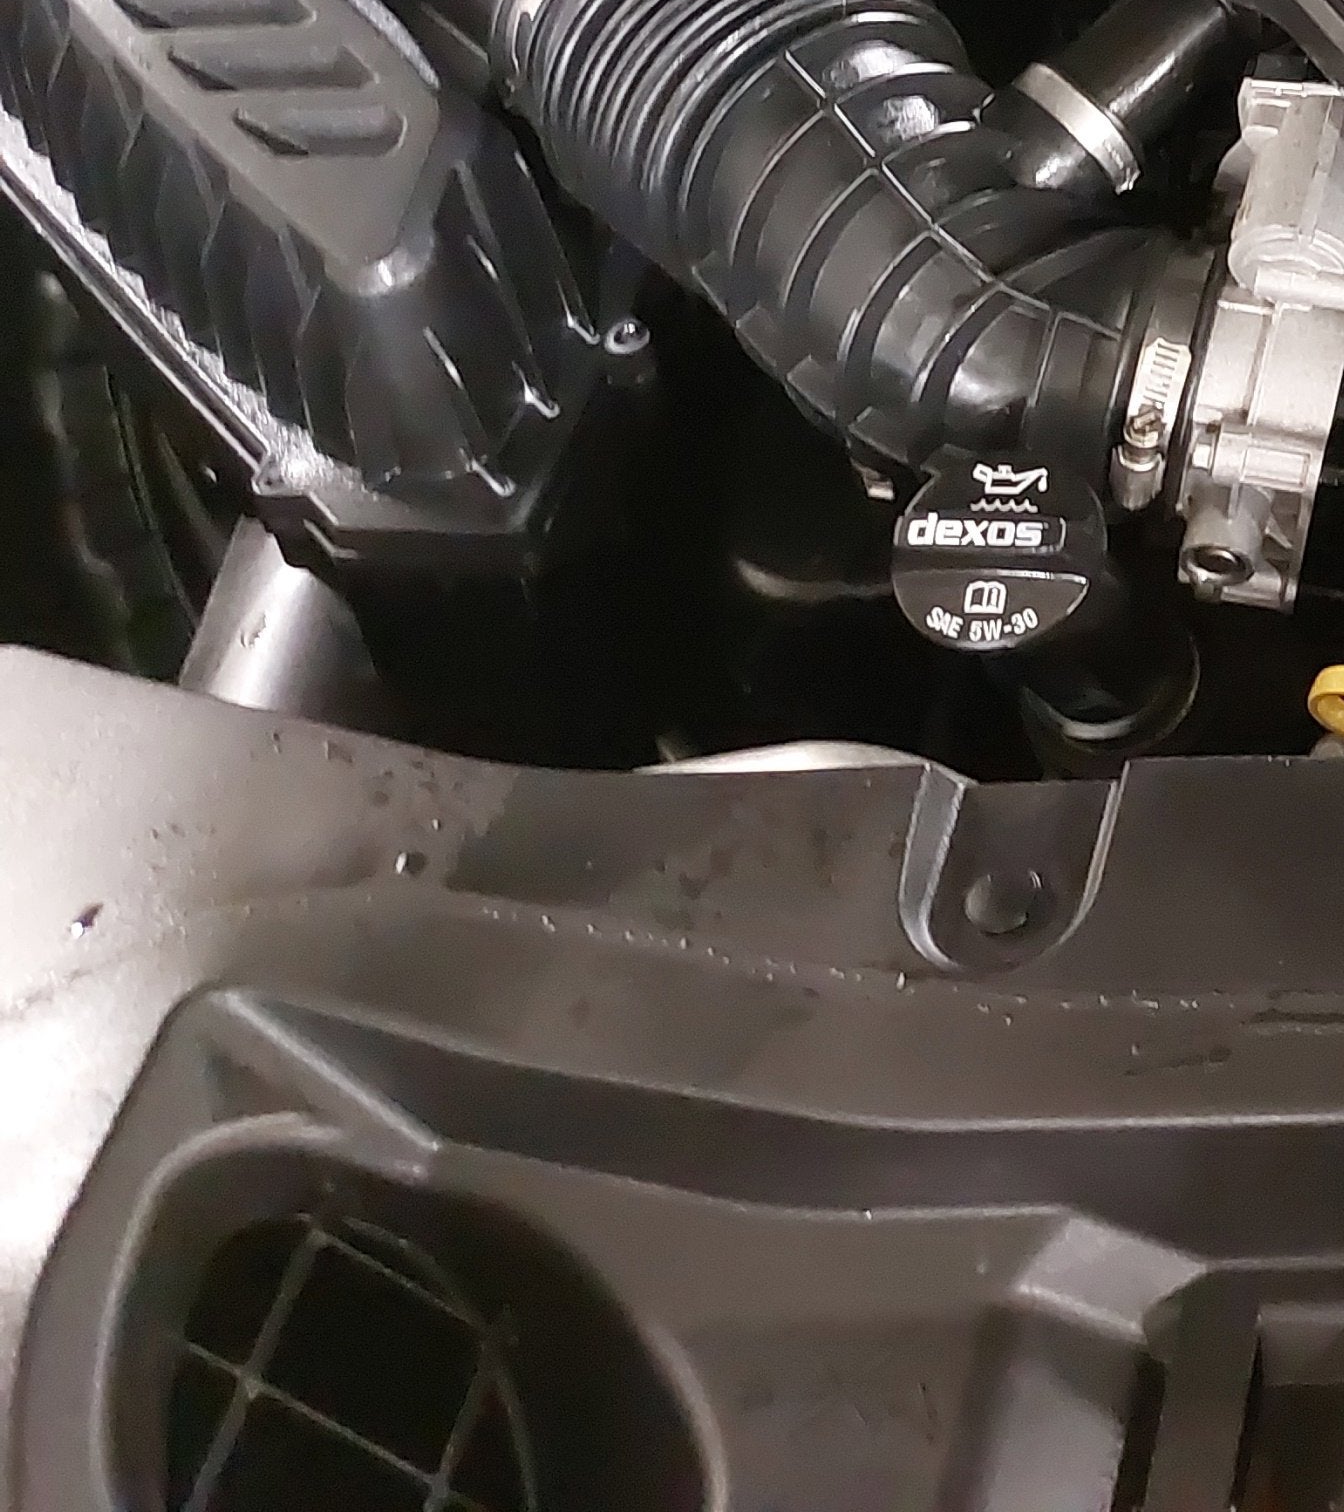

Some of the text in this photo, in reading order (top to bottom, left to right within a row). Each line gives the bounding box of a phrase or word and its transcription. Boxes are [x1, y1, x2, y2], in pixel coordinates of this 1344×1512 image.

[907, 511, 1044, 547] dexos
[926, 606, 1039, 642] SAE 5W-30
